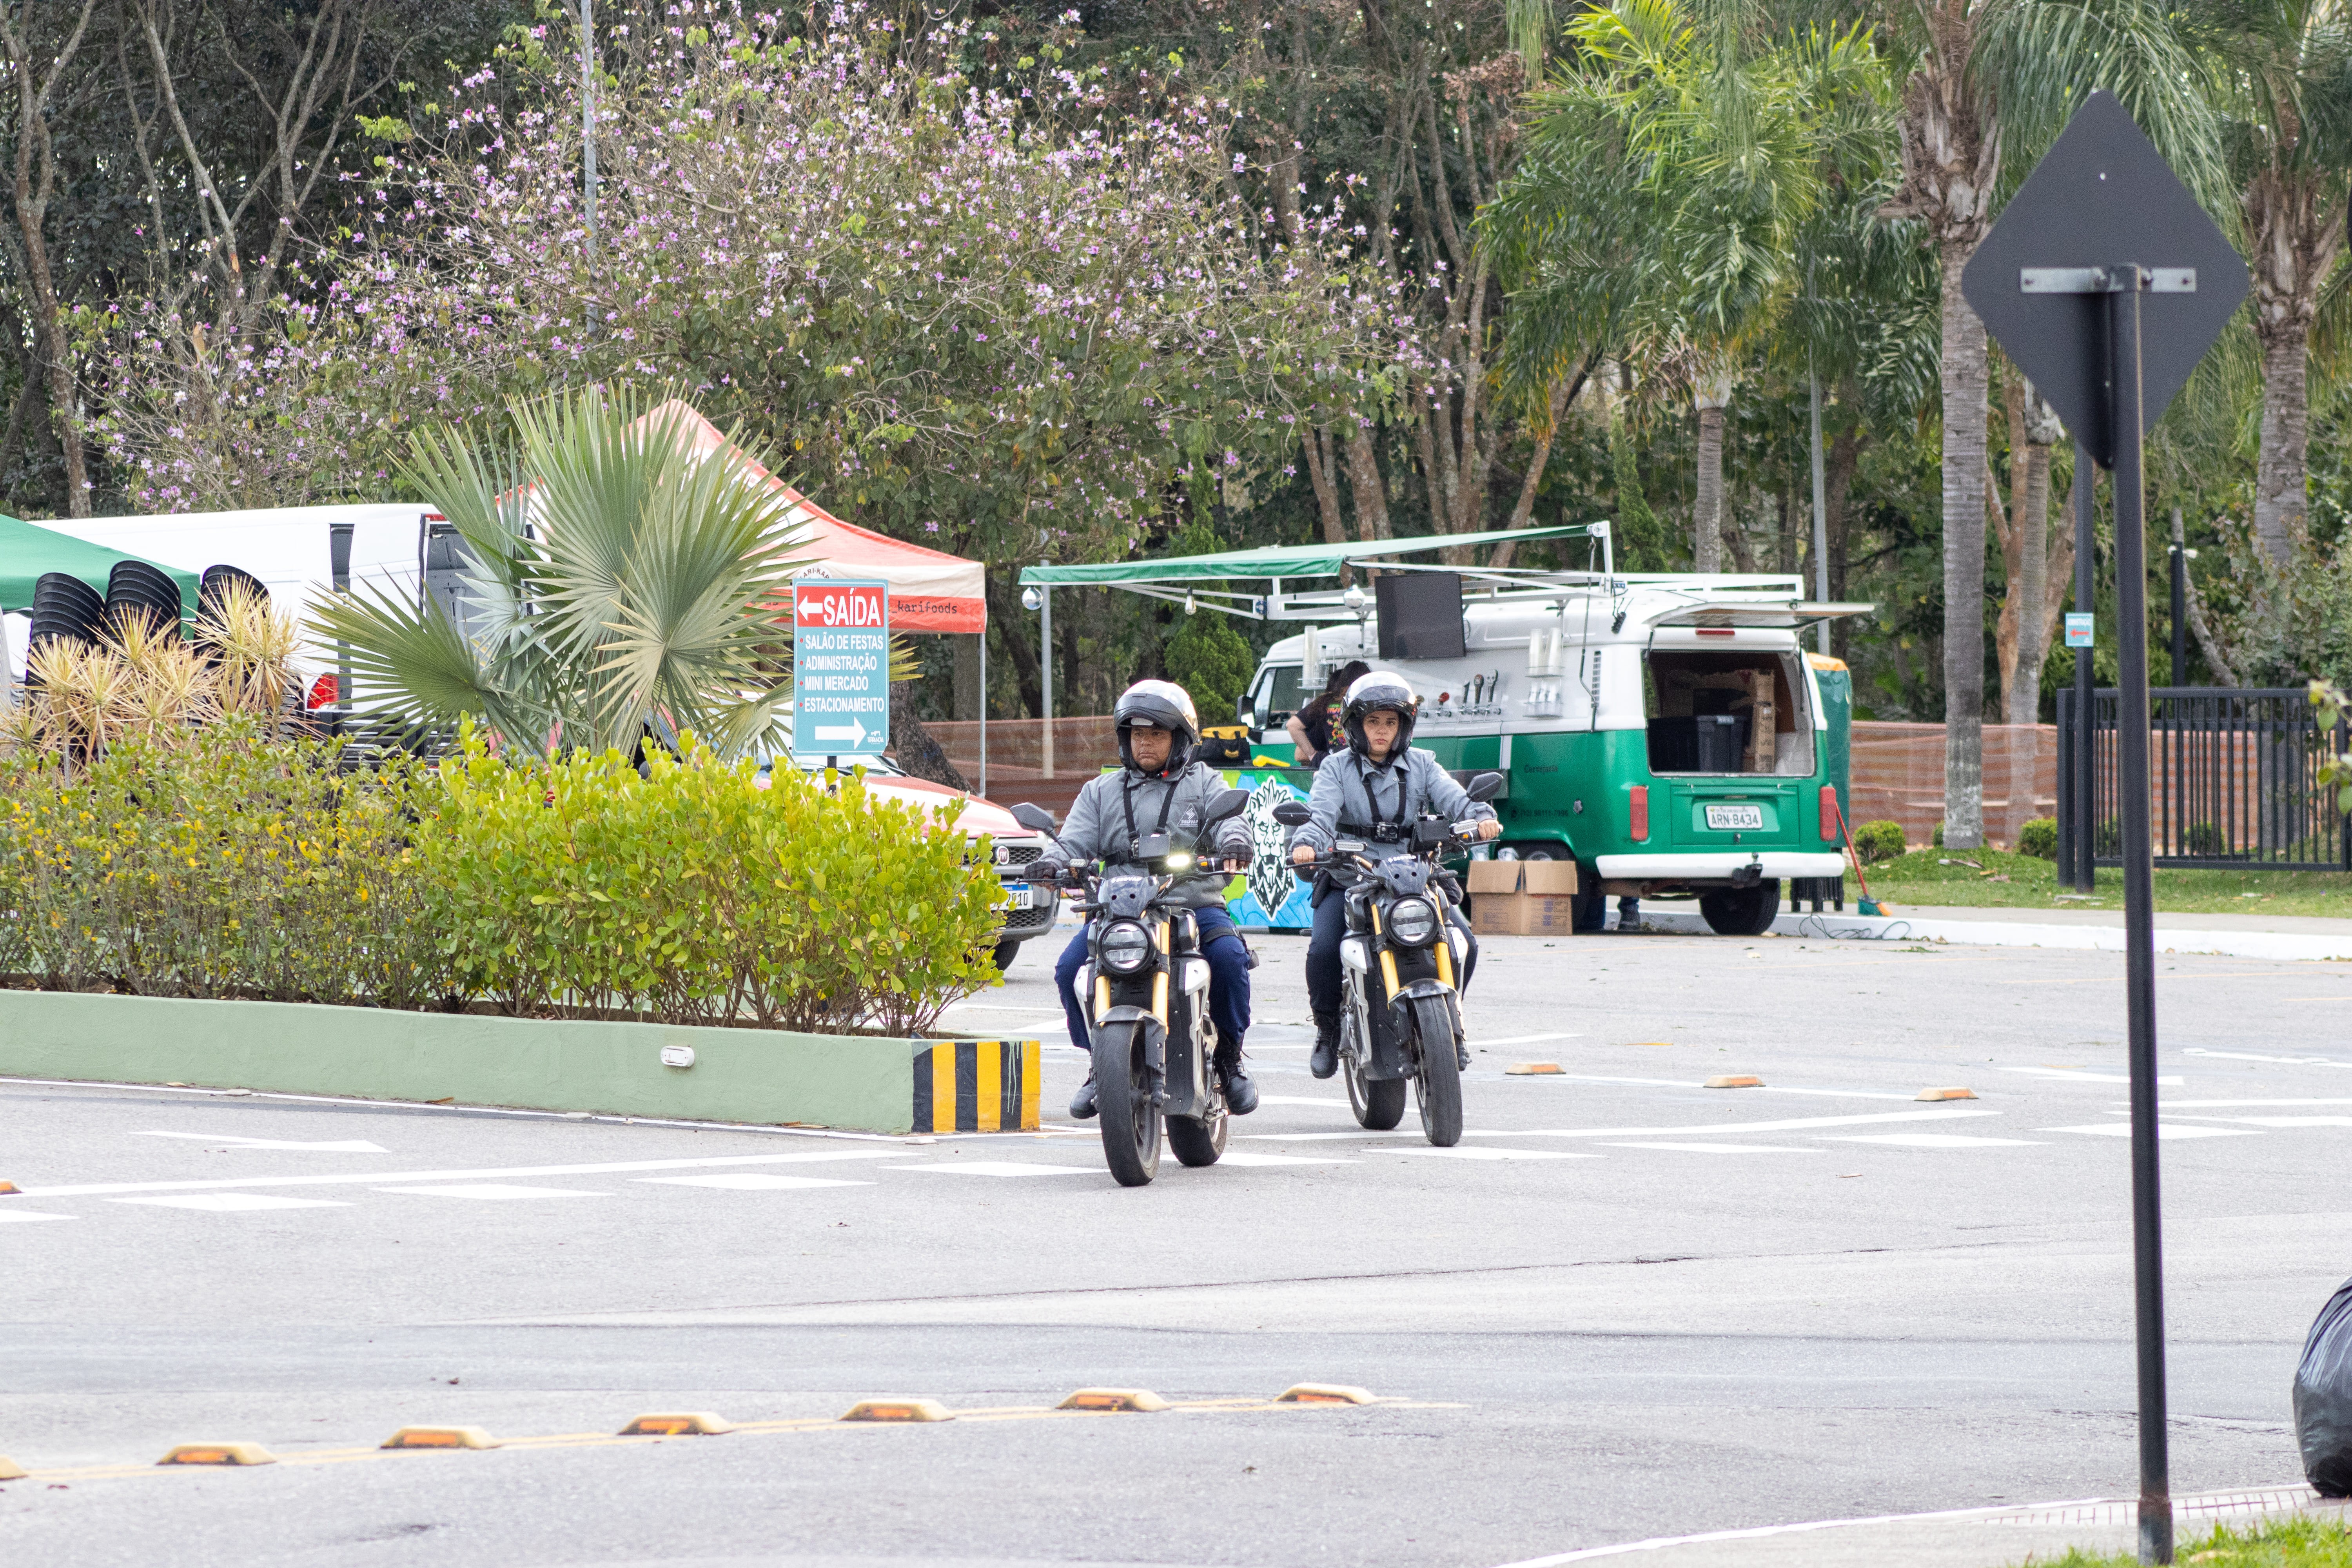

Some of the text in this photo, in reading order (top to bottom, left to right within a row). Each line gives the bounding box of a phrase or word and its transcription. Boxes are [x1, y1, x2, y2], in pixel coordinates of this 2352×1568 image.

[823, 588, 881, 626] SAÍDA
[805, 632, 883, 650] SALÃO DE FESTAS
[805, 652, 877, 674] ADMINISTRAÇÃO
[805, 676, 869, 691] MINI MERCADO
[805, 697, 884, 713] ESTACIONAMENTO
